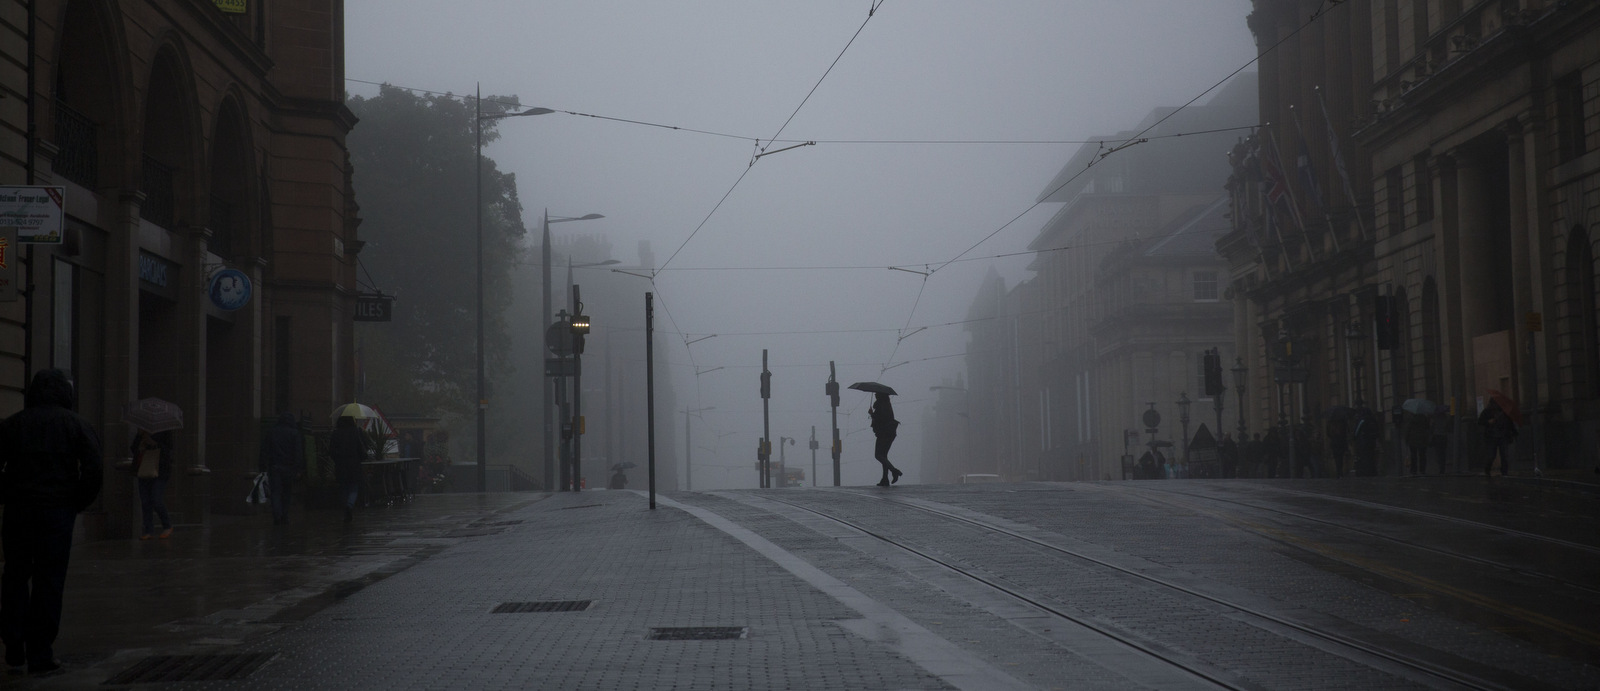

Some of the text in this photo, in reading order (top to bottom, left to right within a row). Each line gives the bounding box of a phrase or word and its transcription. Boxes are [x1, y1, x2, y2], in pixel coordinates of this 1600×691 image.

[36, 194, 49, 204] Legal
[139, 254, 167, 287] BARCLAYS
[354, 302, 384, 317] ILES
